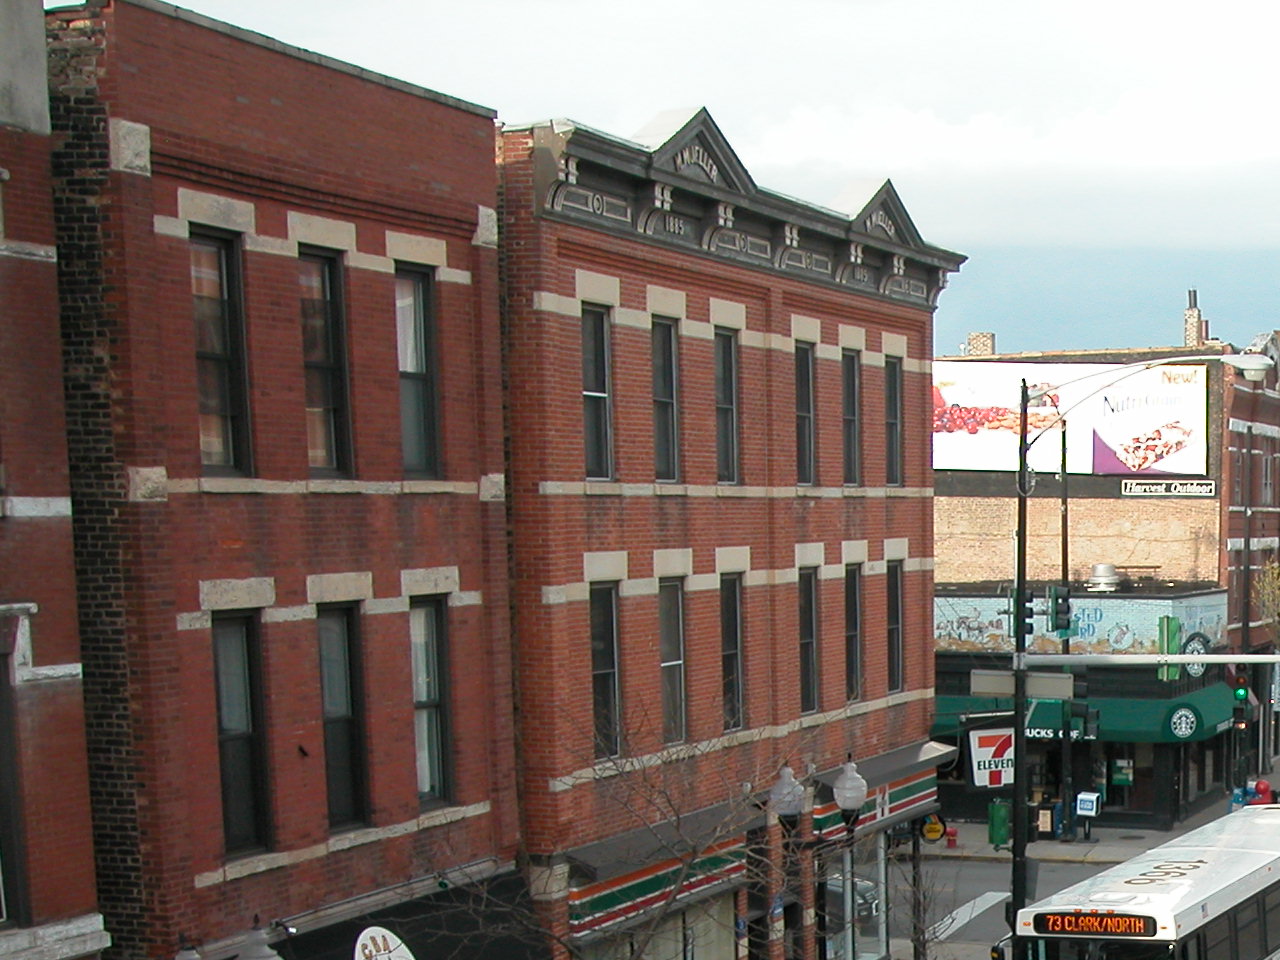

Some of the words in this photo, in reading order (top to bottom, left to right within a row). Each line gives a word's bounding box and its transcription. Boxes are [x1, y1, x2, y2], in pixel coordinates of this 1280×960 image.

[1125, 482, 1167, 494] Harvest
[1170, 482, 1212, 494] Outdoor
[1046, 915, 1062, 931] 73
[1064, 916, 1144, 933] CLARK/NORTH
